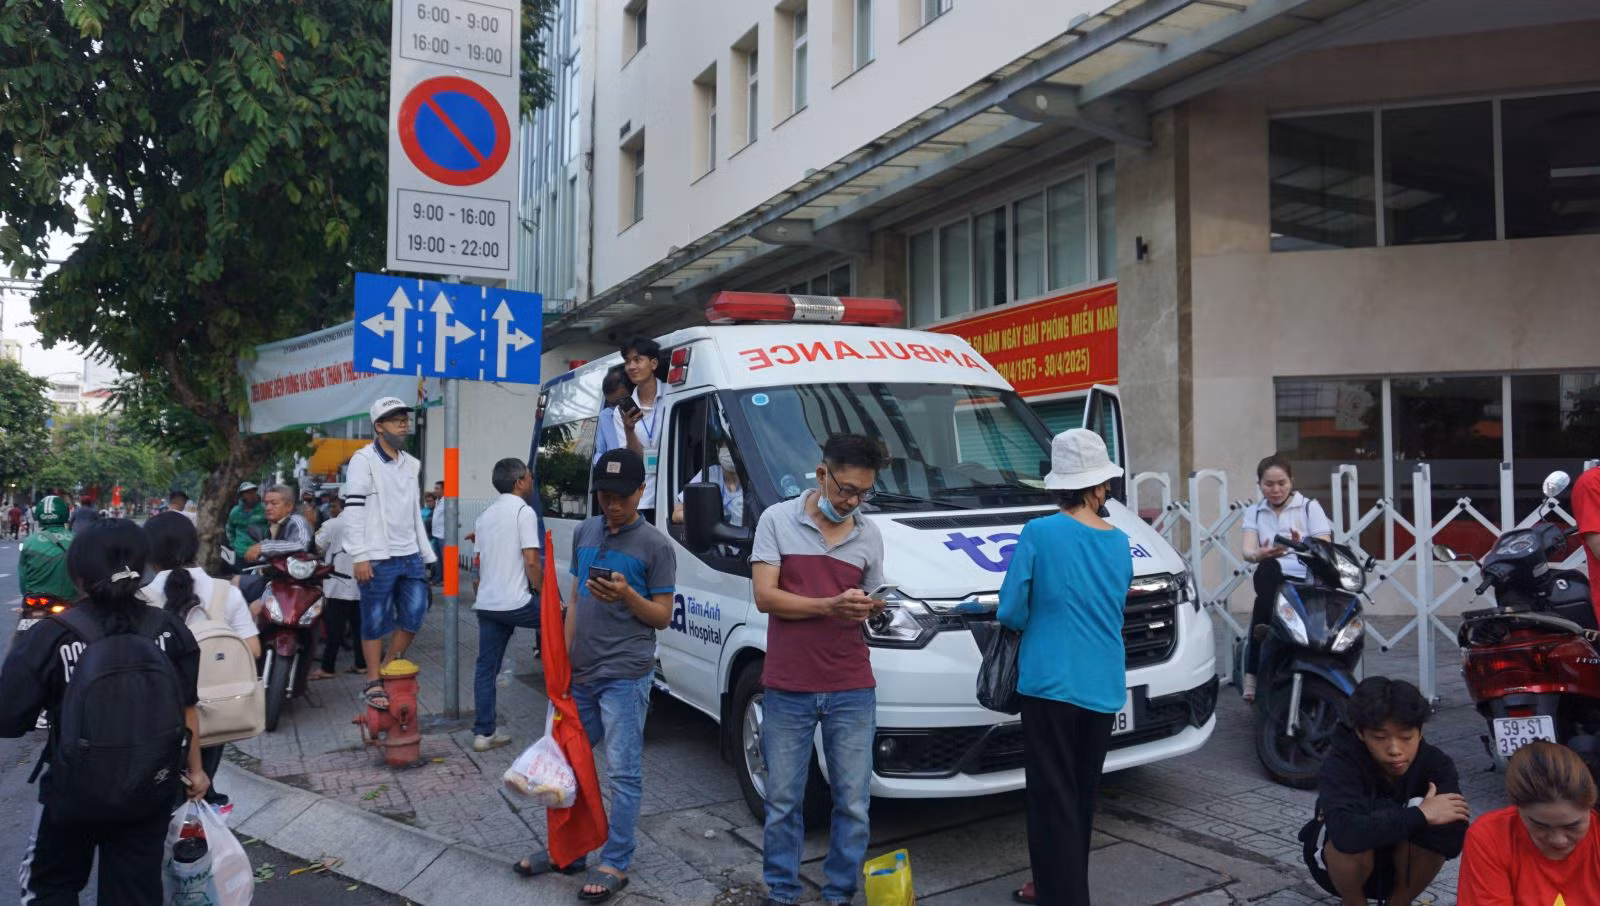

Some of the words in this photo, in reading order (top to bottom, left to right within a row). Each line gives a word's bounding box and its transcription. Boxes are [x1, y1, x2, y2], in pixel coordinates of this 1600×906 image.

[417, 3, 450, 24] 6:00
[467, 13, 499, 33] 9:00
[413, 33, 449, 55] 16:00
[468, 43, 502, 64] 19:00
[413, 202, 444, 222] 9:00
[460, 207, 496, 227] 16:00
[408, 234, 445, 254] 19:00
[461, 239, 499, 258] 22:00
[1001, 322, 1021, 350] NGÀY
[1023, 317, 1039, 346] GIẢI
[1041, 312, 1070, 342] PHÓNG
[1071, 303, 1094, 337] MIỀN
[1096, 304, 1117, 331] NAM
[1044, 347, 1090, 377] 30/4/2025)
[688, 620, 722, 646] Hospital
